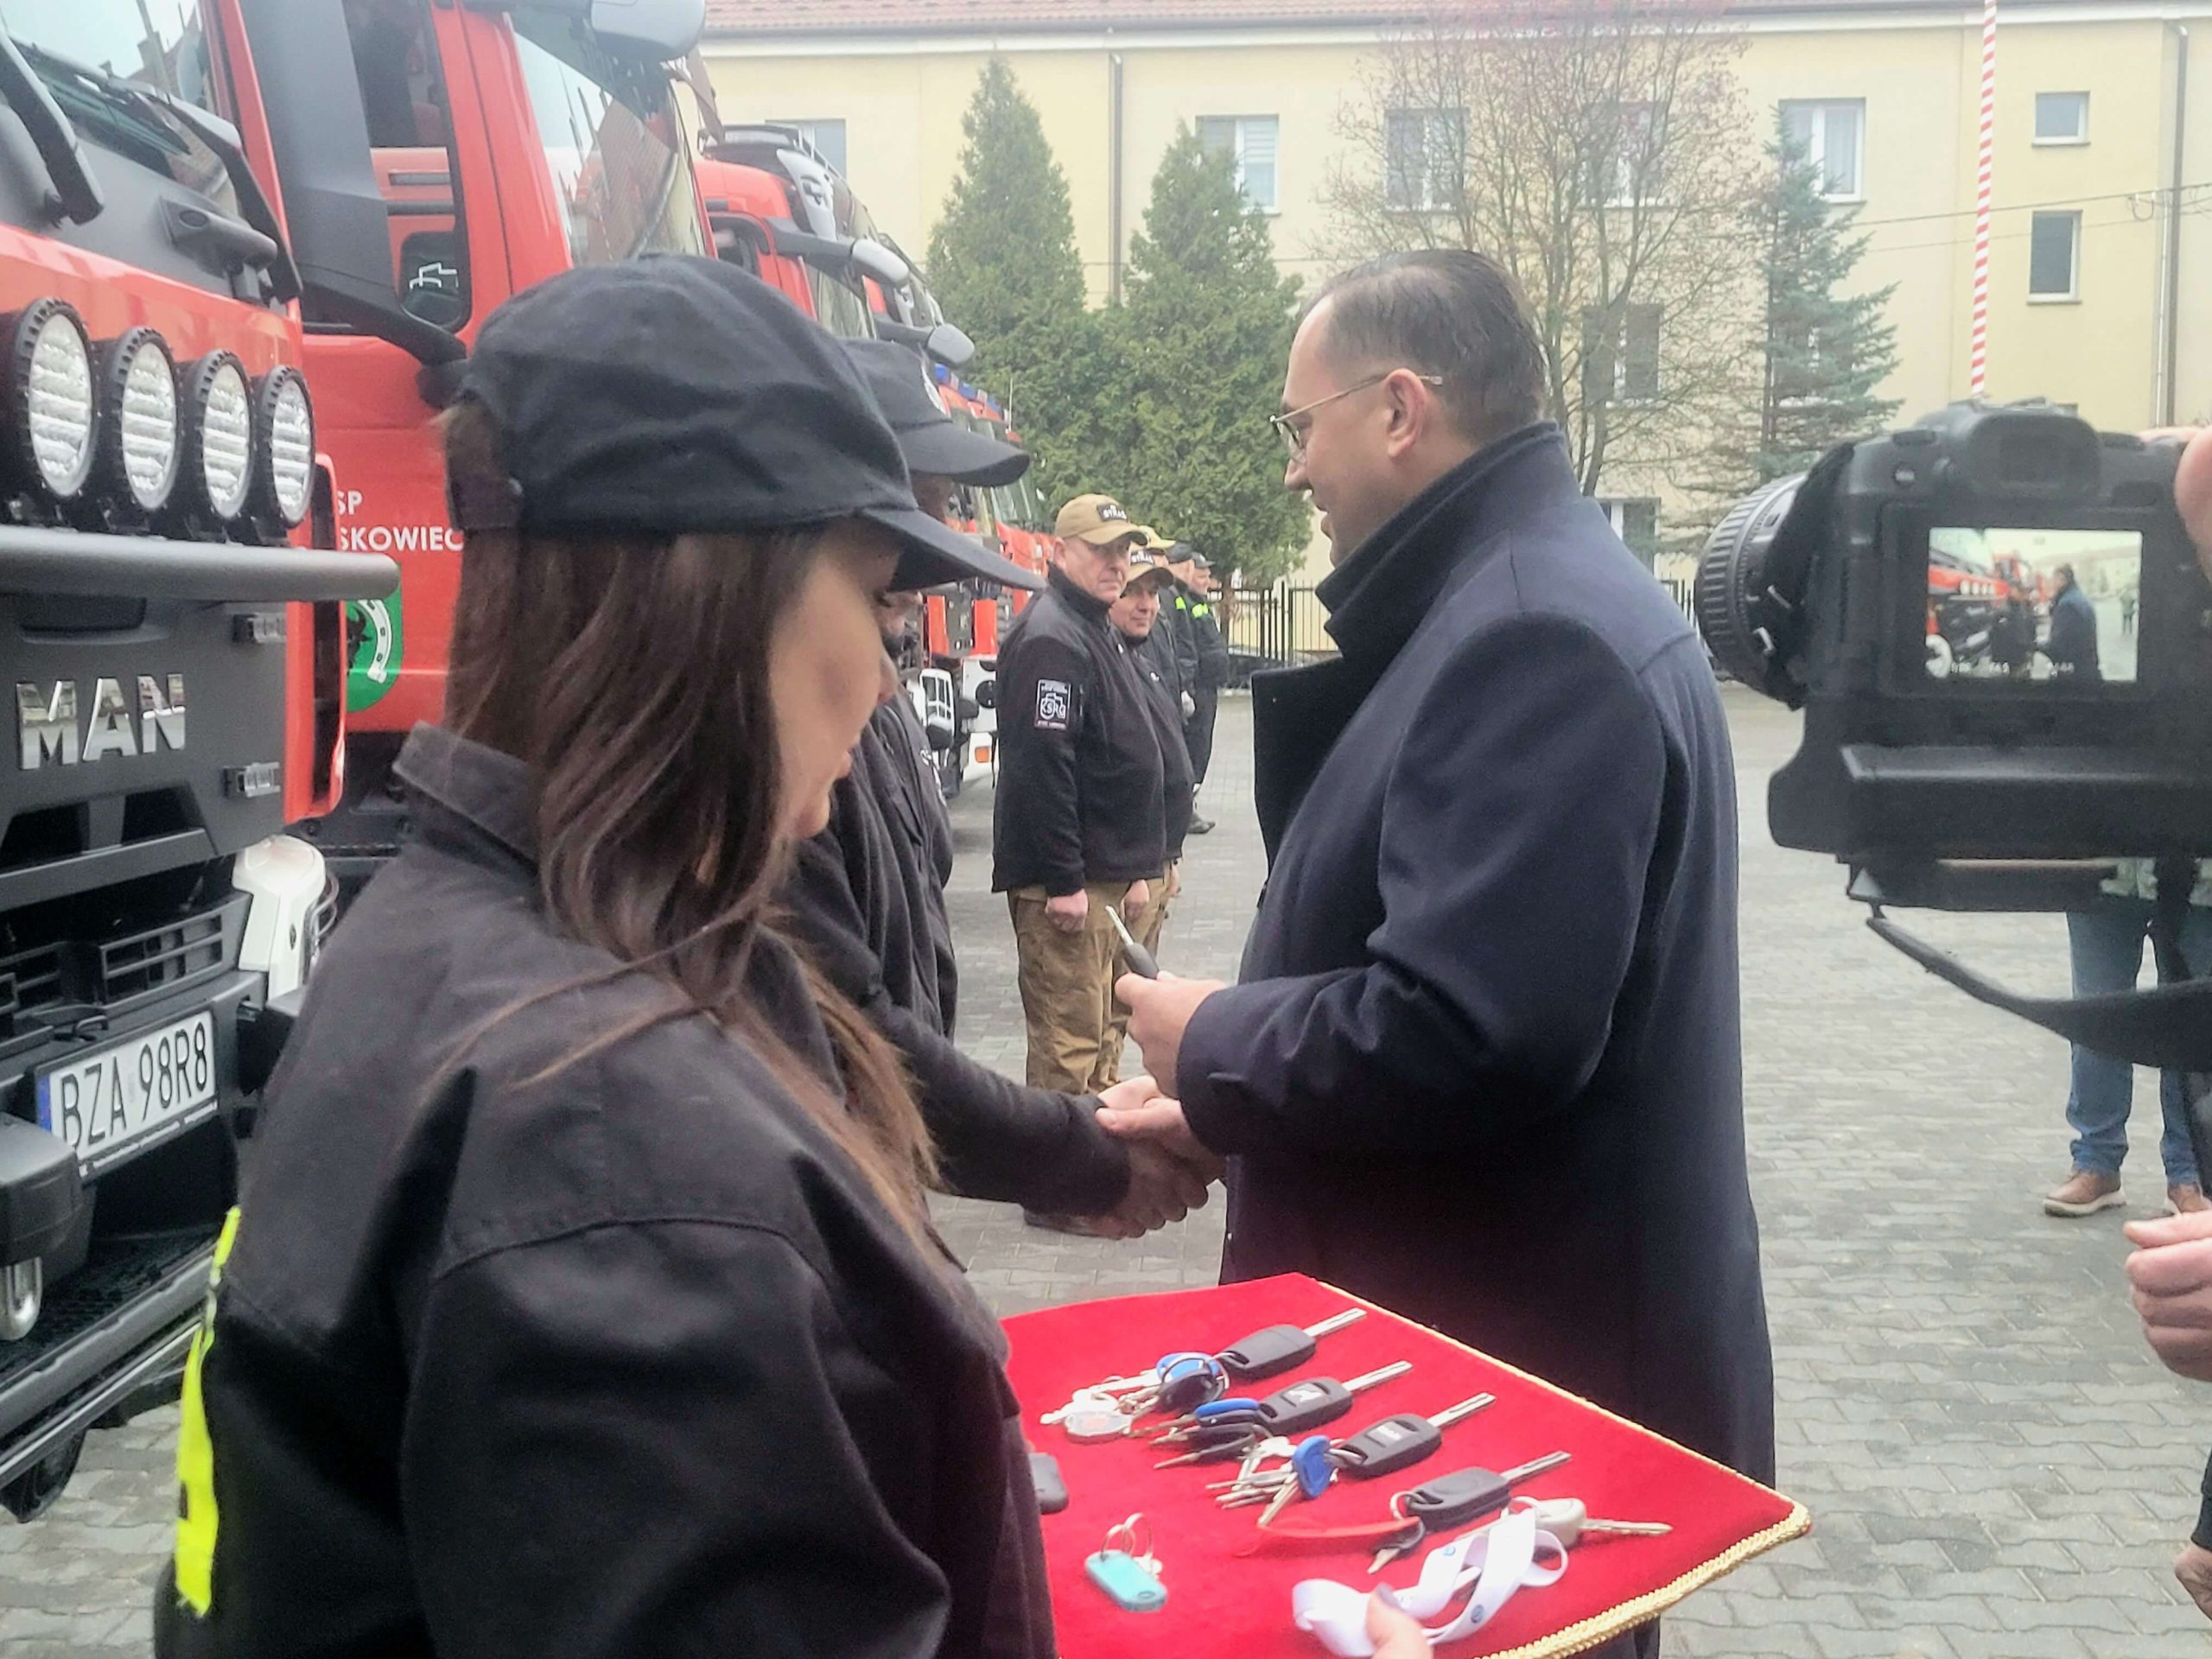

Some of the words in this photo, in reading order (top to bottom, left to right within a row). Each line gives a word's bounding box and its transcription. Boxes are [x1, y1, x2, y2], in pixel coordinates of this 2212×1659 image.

[16, 673, 186, 771] MAN
[60, 1055, 127, 1148] BZA
[139, 1020, 208, 1122] 98R8
